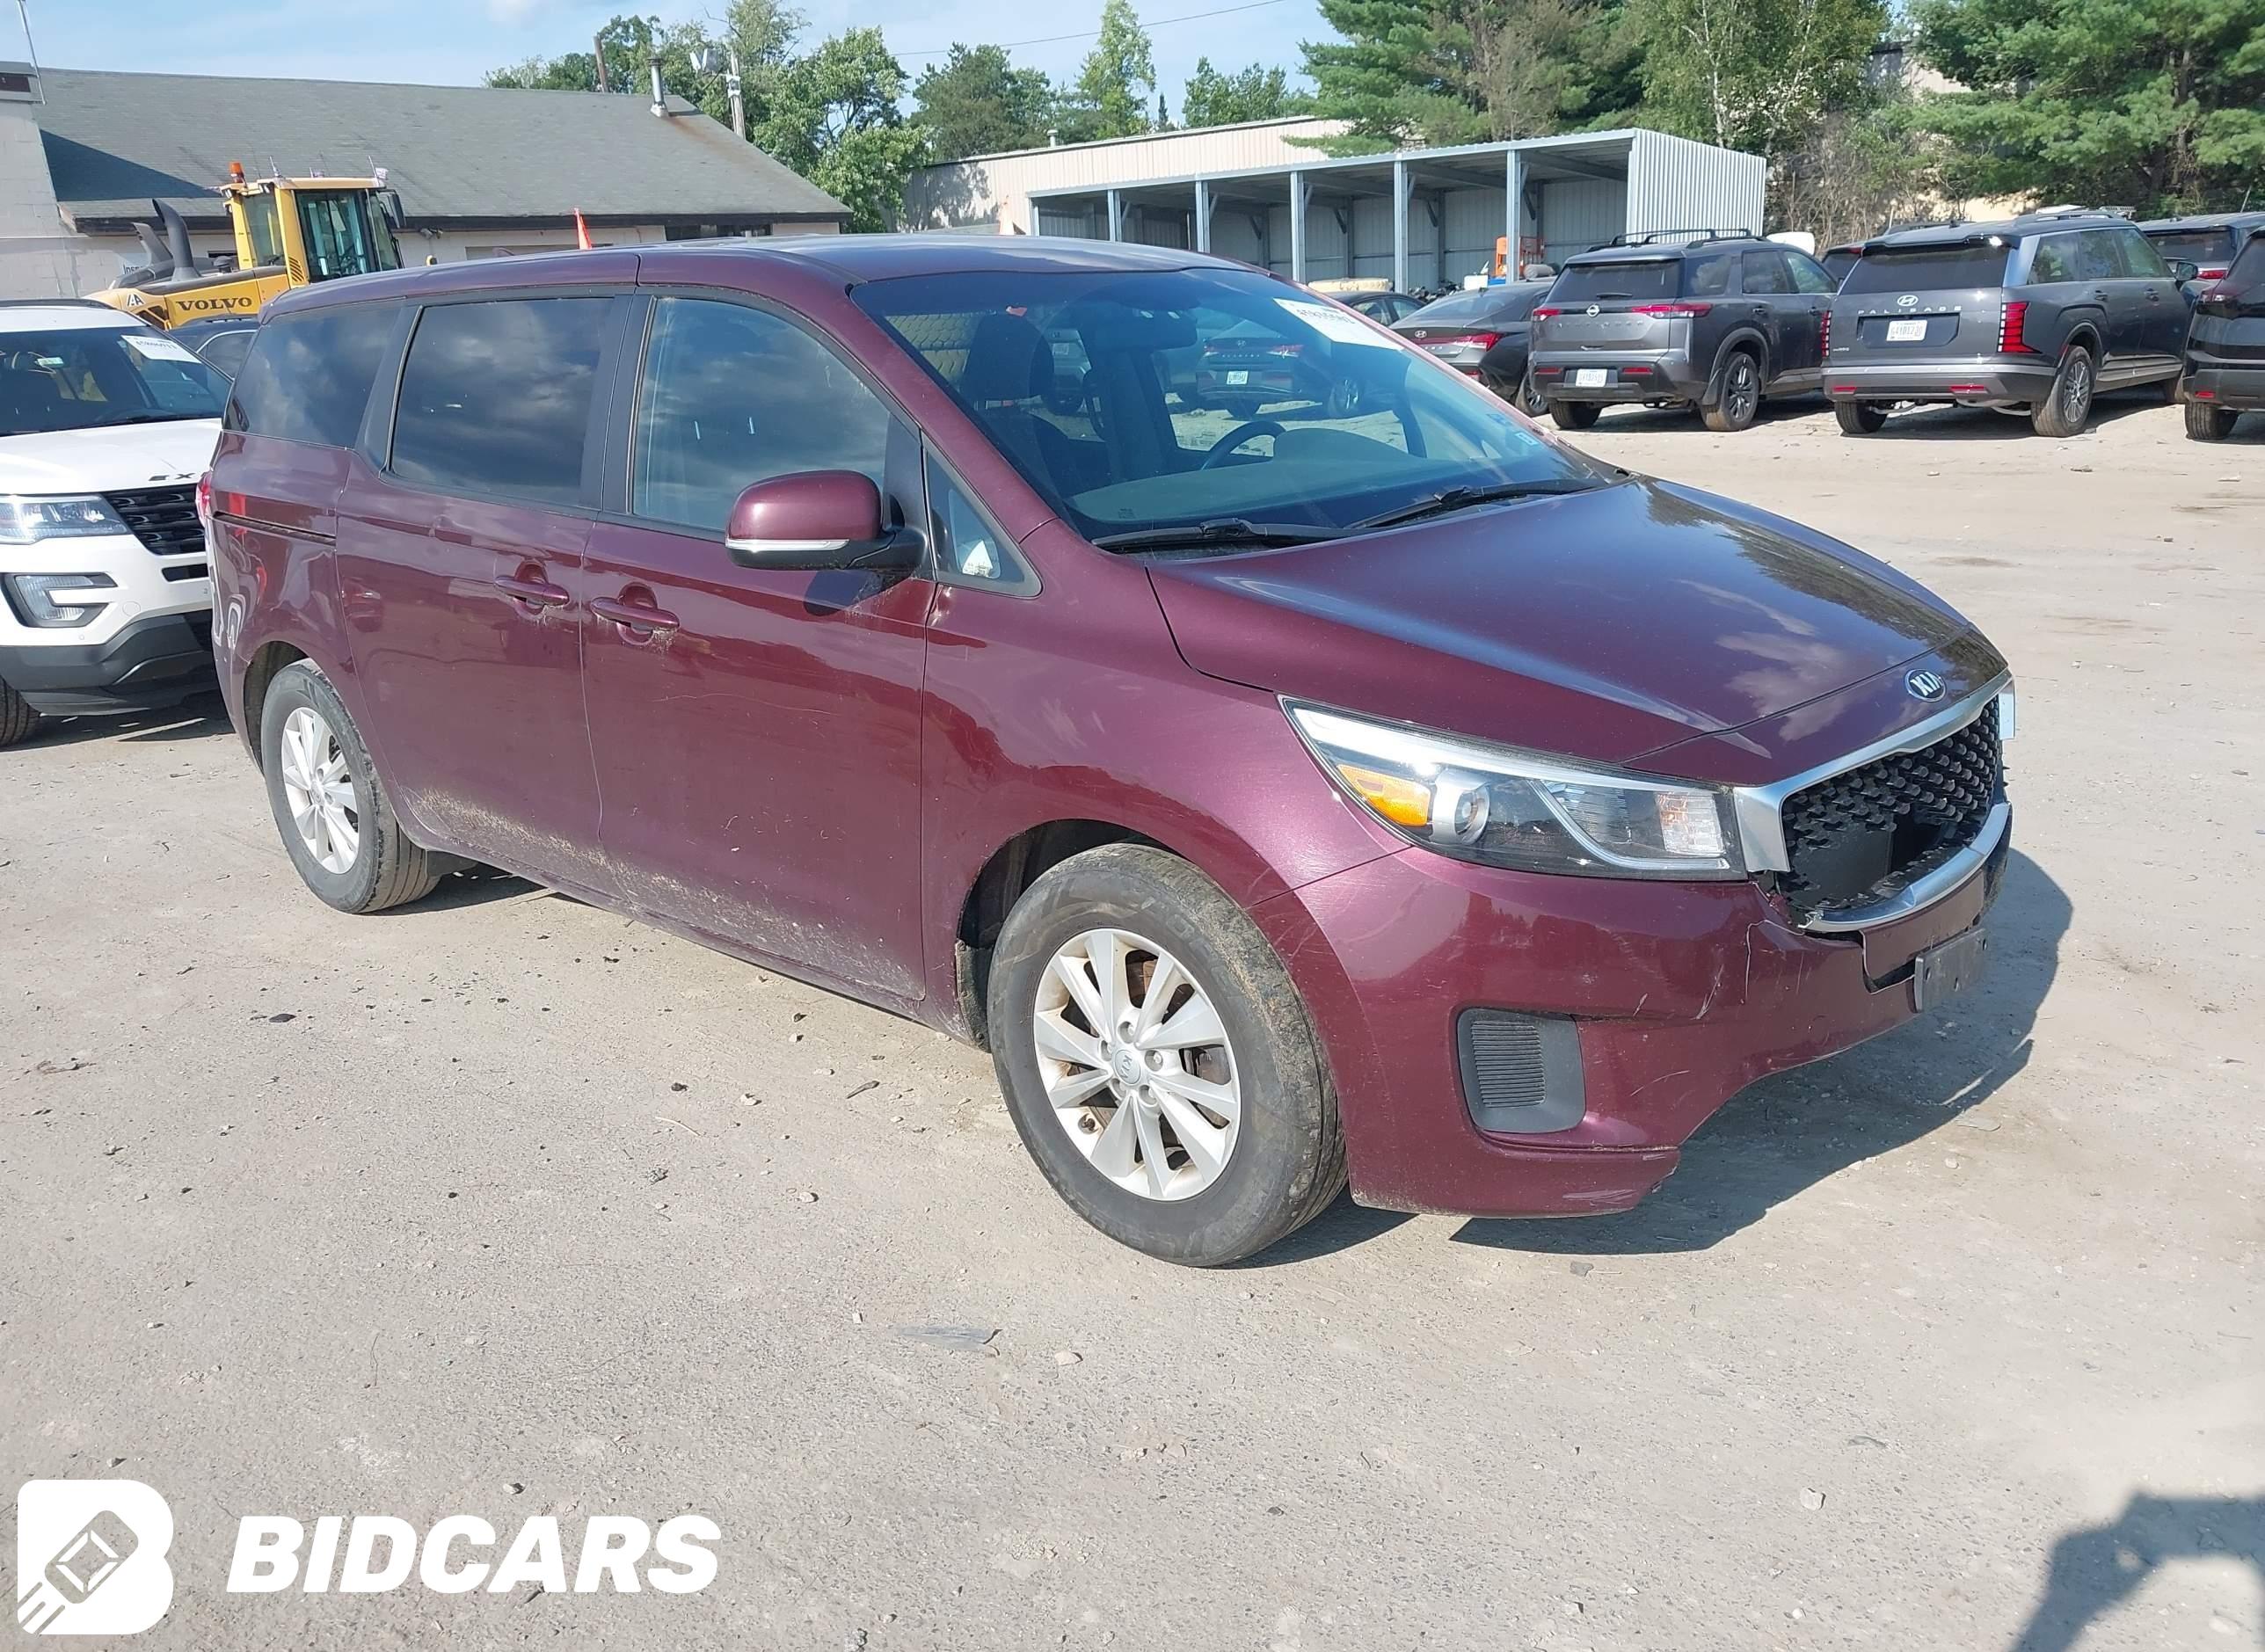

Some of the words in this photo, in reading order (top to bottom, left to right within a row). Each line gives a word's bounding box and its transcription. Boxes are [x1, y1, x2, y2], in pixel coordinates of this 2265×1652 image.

[176, 297, 252, 311] VOLVO
[1858, 305, 1962, 315] PALISADE
[1910, 671, 1941, 696] KIA
